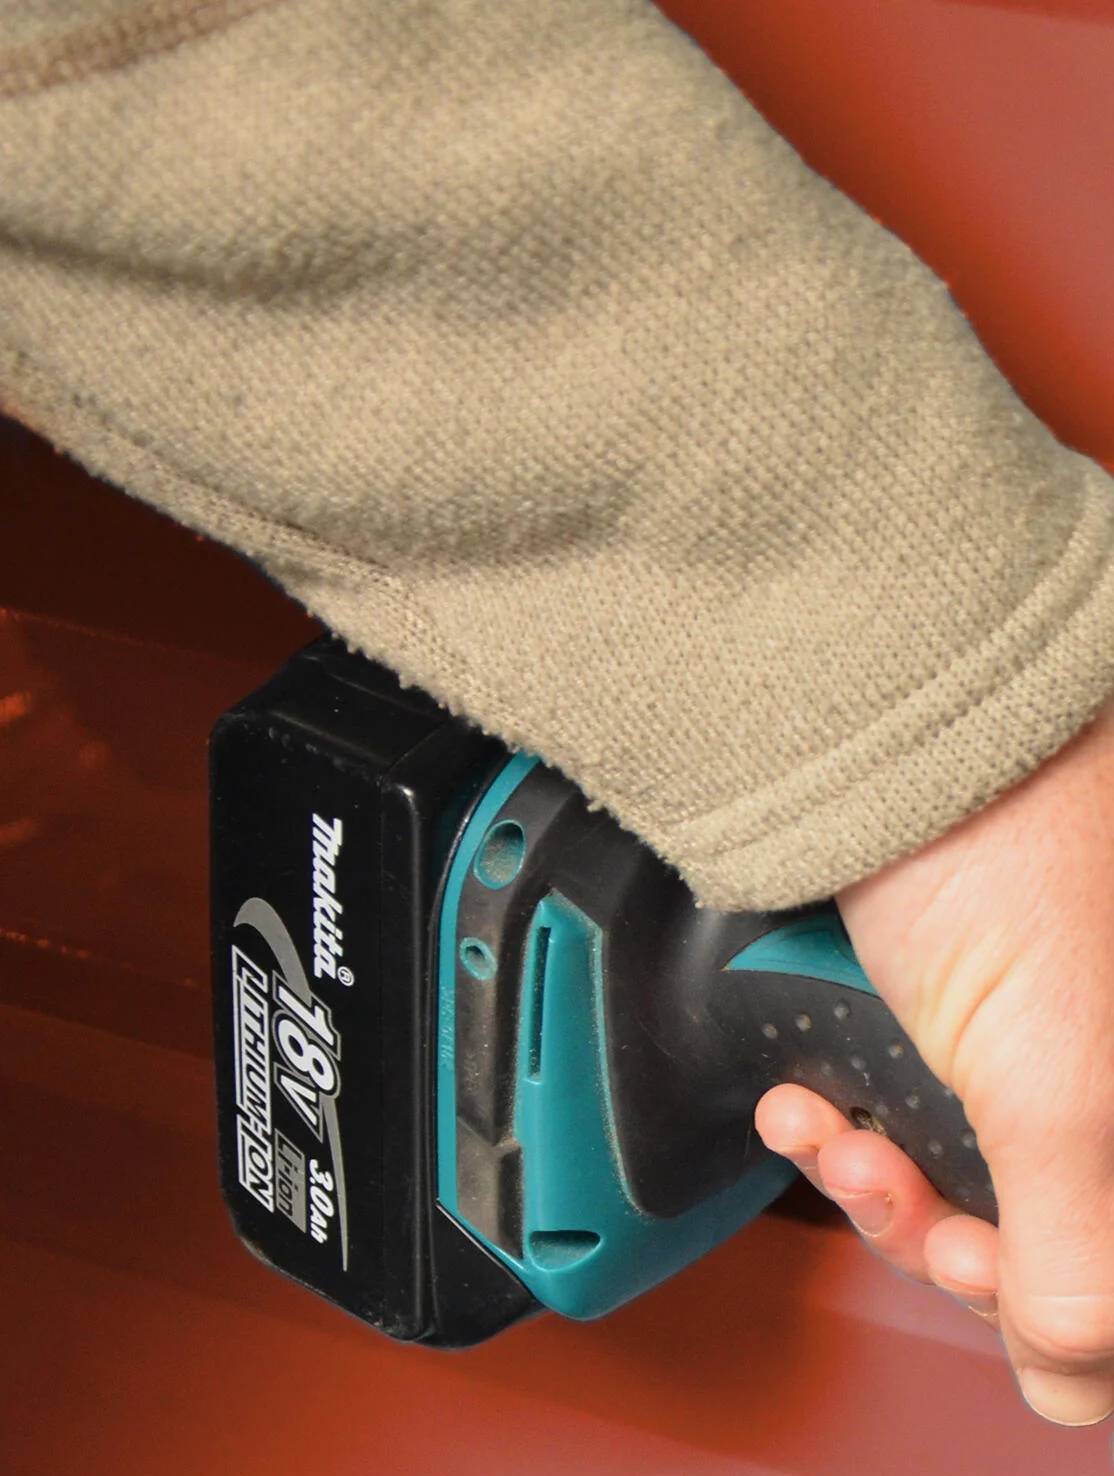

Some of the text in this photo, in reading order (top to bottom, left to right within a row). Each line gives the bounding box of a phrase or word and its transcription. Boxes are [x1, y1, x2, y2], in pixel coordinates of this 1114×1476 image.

[231, 945, 273, 1212] LITHIUM-ION
[276, 1134, 304, 1217] Li-ion
[306, 1158, 334, 1244] 3.0Ah
